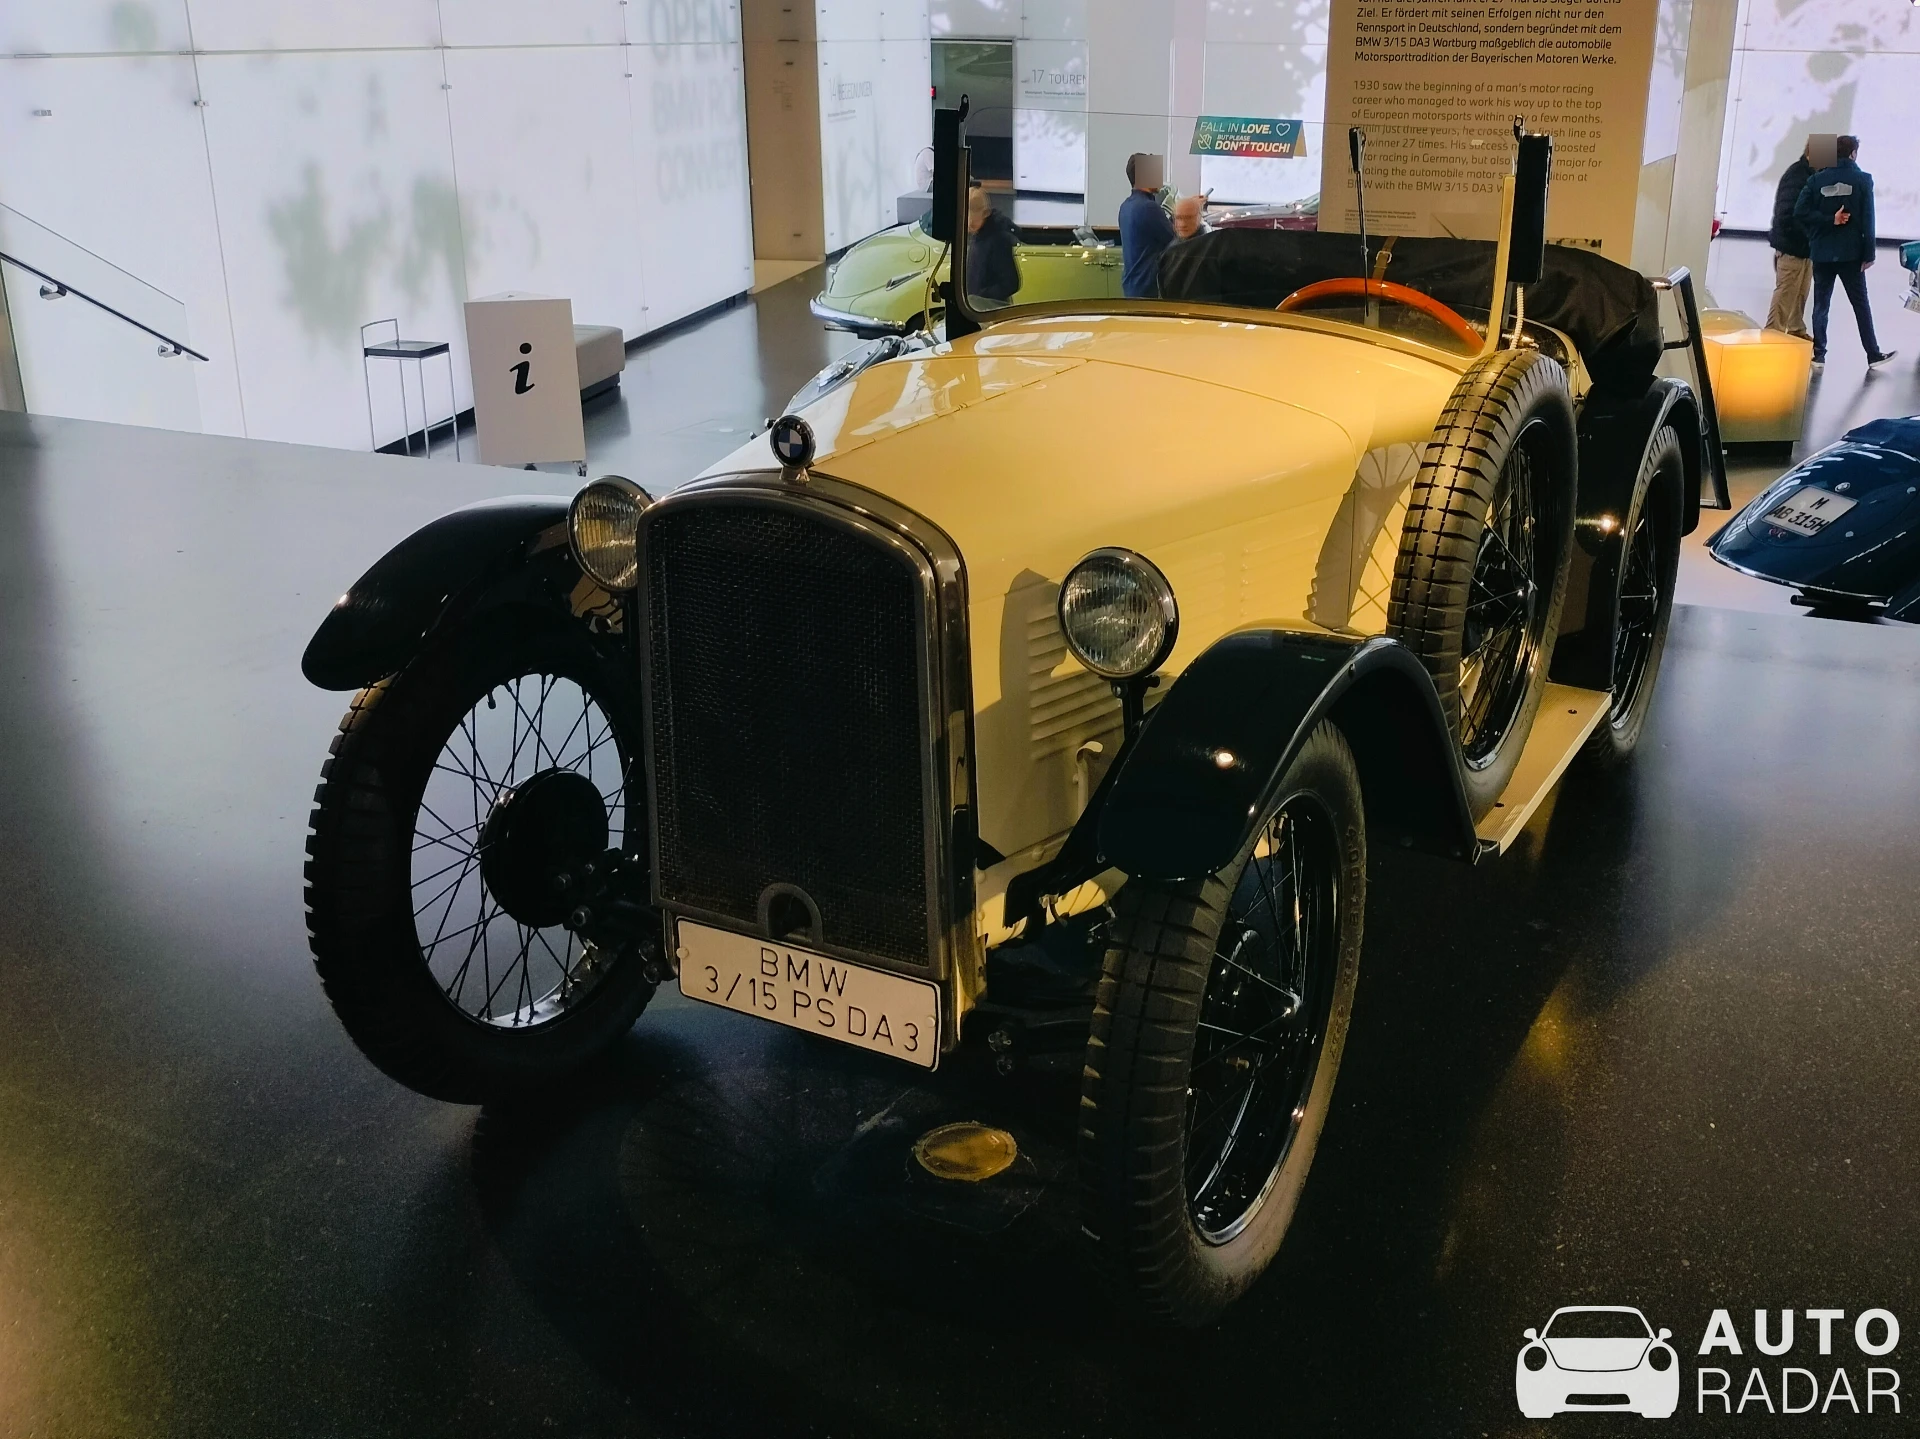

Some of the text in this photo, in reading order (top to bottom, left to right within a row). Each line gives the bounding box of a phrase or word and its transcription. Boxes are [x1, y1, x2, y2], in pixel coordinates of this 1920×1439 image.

[1357, 7, 1604, 20] Ziel. Er fördert mit seinen Erfolgen nicht nur den
[1356, 22, 1622, 35] Rennsport in Deutschland, sondern begründet mit dem
[1355, 37, 1612, 50] BMW 3/15 DA3 Wartburg maßgeblich die automobile
[1354, 51, 1617, 65] Motorsporttradition der Bayerischen Motoren Werke.
[1032, 69, 1045, 84] 17
[1354, 80, 1594, 96] 1930 saw the beginning of a man's motor racing
[1352, 96, 1602, 110] career who managed to work his way up to the top
[1351, 109, 1361, 119] of
[1363, 109, 1409, 121] European
[1412, 111, 1471, 122] motorsports
[1474, 112, 1505, 122] within
[1531, 114, 1537, 122] a
[1540, 113, 1559, 122] few
[1561, 114, 1603, 124] months.
[1200, 121, 1272, 135] FALL IN LOVE.
[1382, 124, 1401, 135] just
[1403, 125, 1428, 134] three
[1430, 127, 1459, 137] years,
[1462, 126, 1475, 135] he
[1568, 127, 1586, 138] line
[1589, 130, 1602, 139] as
[1215, 140, 1290, 154] DON'T TOUCH!
[1367, 139, 1400, 148] winner
[1402, 139, 1416, 148] 27
[1418, 139, 1448, 149] times.
[1450, 140, 1466, 150] His
[1469, 142, 1508, 151] success
[1554, 142, 1596, 153] boosted
[1379, 153, 1408, 163] racing
[1411, 153, 1420, 162] in
[1422, 153, 1469, 165] Germany,
[1471, 154, 1488, 164] but
[1490, 155, 1511, 165] also
[1556, 158, 1585, 168] major
[1588, 158, 1602, 168] for
[1391, 167, 1407, 176] the
[1409, 168, 1464, 178] automobile
[1466, 169, 1496, 179] motor
[1577, 173, 1588, 182] at
[1375, 180, 1396, 190] with
[1398, 181, 1413, 191] the
[1416, 181, 1442, 191] BMW
[1445, 182, 1468, 193] 3/15
[1471, 183, 1494, 193] DA3
[1810, 497, 1830, 510] M
[1768, 506, 1830, 532] AB 315H
[760, 946, 848, 997] BMW
[704, 965, 777, 1010] 3/15
[793, 989, 836, 1028] PS
